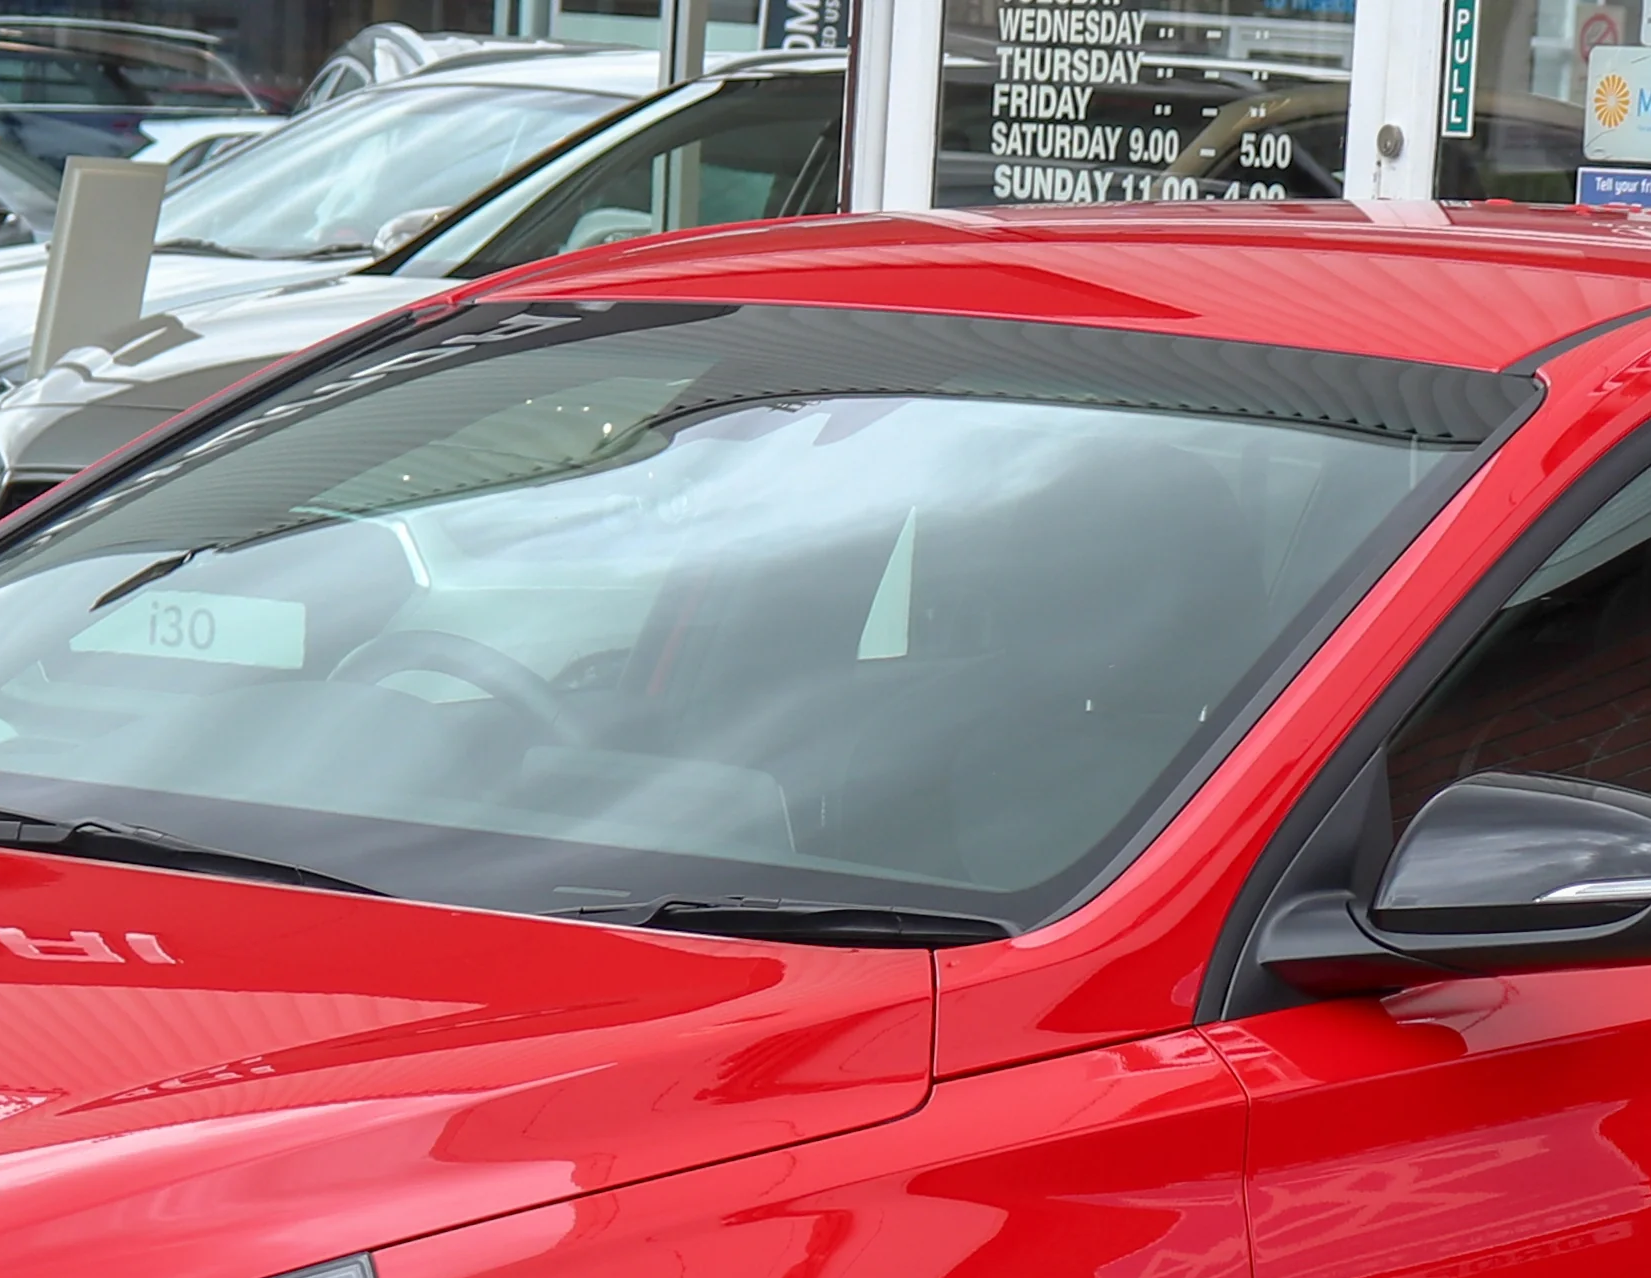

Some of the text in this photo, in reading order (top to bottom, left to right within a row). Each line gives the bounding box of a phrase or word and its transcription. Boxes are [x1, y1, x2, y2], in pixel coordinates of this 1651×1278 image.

[998, 7, 1147, 46] WEDNESDAY
[996, 47, 1145, 85] THURSDAY
[1450, 9, 1470, 123] PULL
[992, 85, 1093, 121] FRIDAY
[991, 121, 1122, 161] SATURDAY
[1128, 127, 1180, 164] 9.00
[1240, 132, 1292, 169] 5.00
[993, 163, 1114, 203] SUNDAY
[1121, 173, 1198, 201] 1100
[1594, 176, 1613, 193] Tell
[1615, 179, 1638, 195] your
[148, 600, 216, 650] i30
